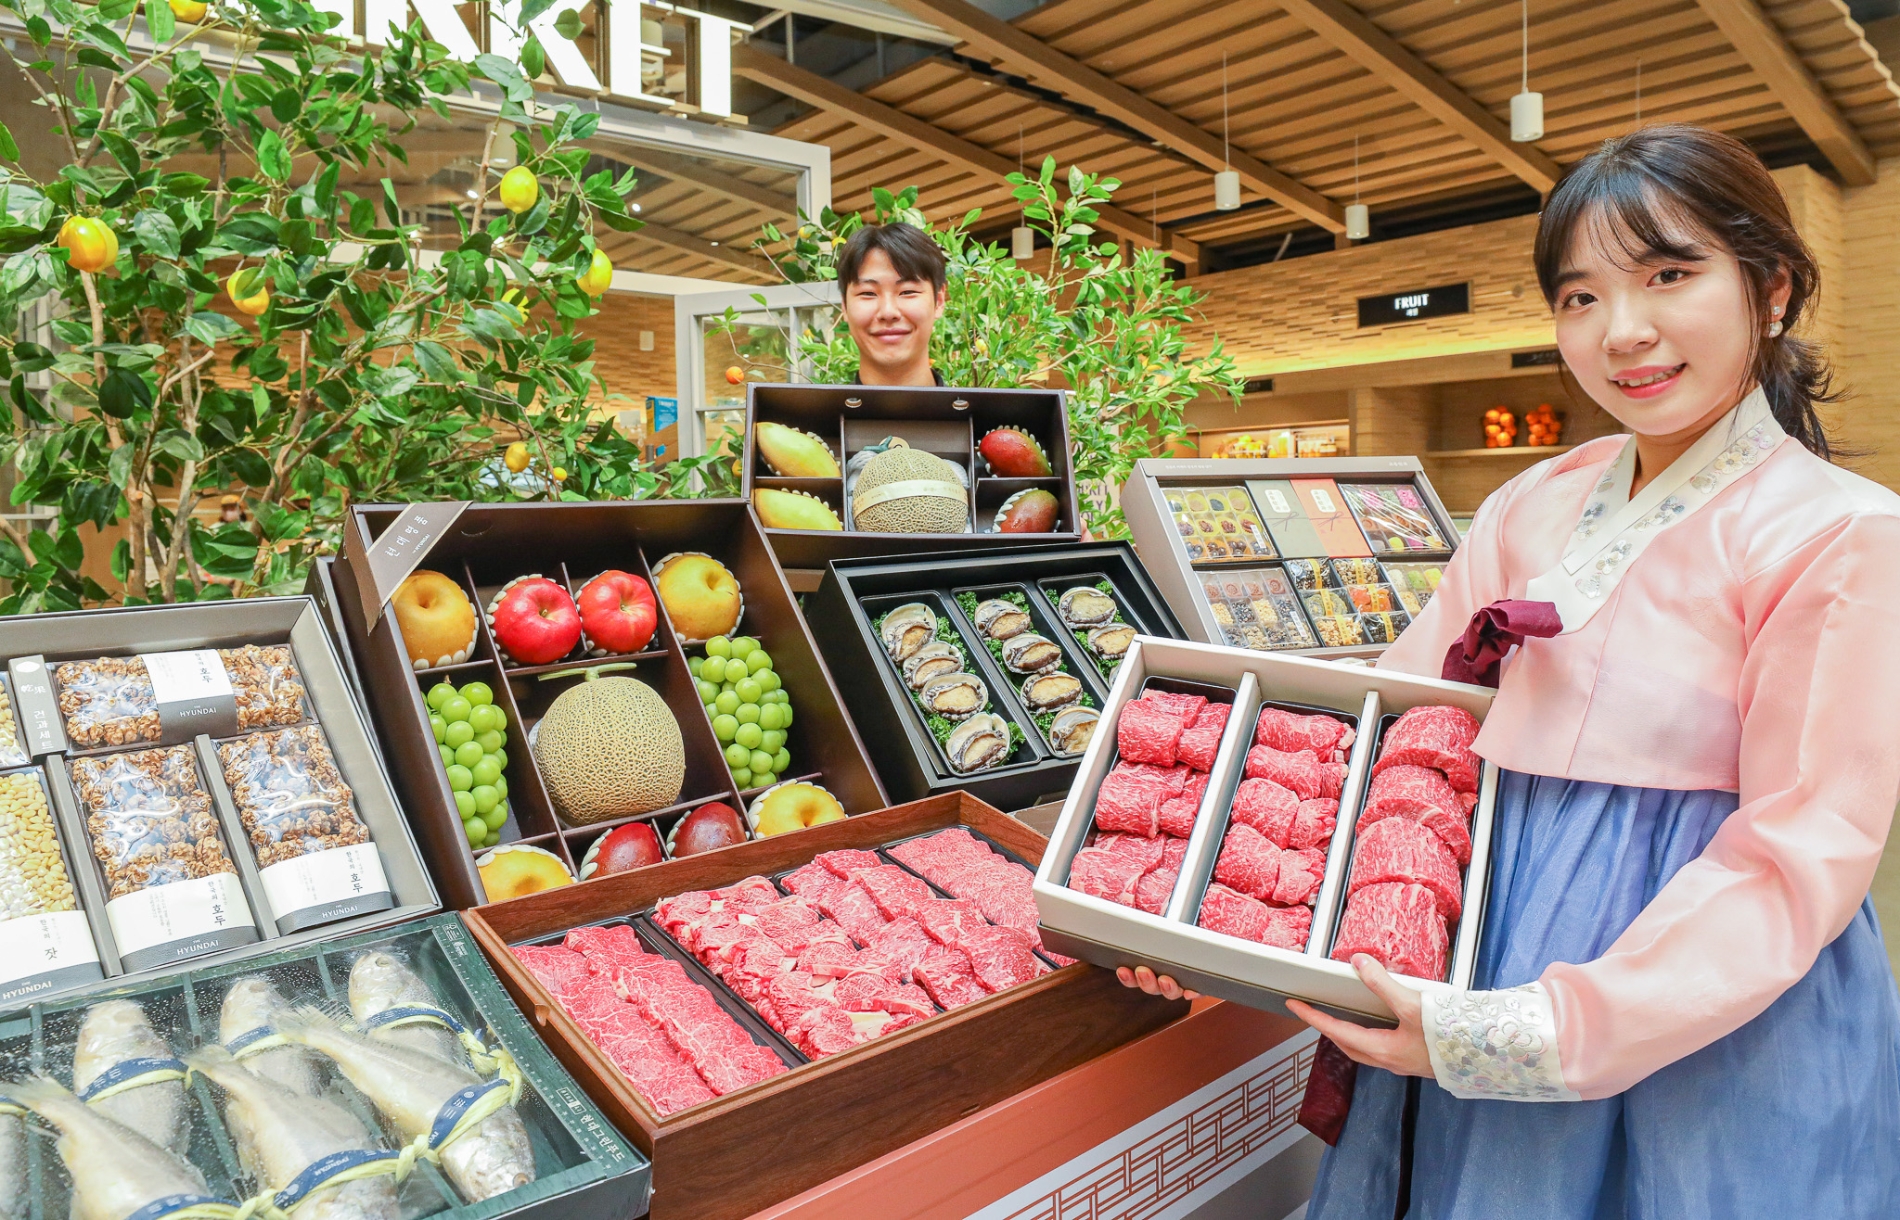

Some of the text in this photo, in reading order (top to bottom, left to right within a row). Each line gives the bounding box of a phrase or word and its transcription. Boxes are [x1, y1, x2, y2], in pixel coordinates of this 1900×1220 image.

[1394, 293, 1430, 311] FRUIT
[179, 707, 217, 718] HYUNDAI
[33, 710, 54, 750] 건과세트
[350, 872, 364, 894] 호두
[212, 903, 227, 926] 호두
[321, 905, 359, 920] HYUNDAI
[44, 946, 58, 961] 잣
[176, 940, 219, 956] HYUNDAI
[2, 980, 53, 1000] HYUNDAI
[579, 1113, 626, 1163] 현대그린푸드
